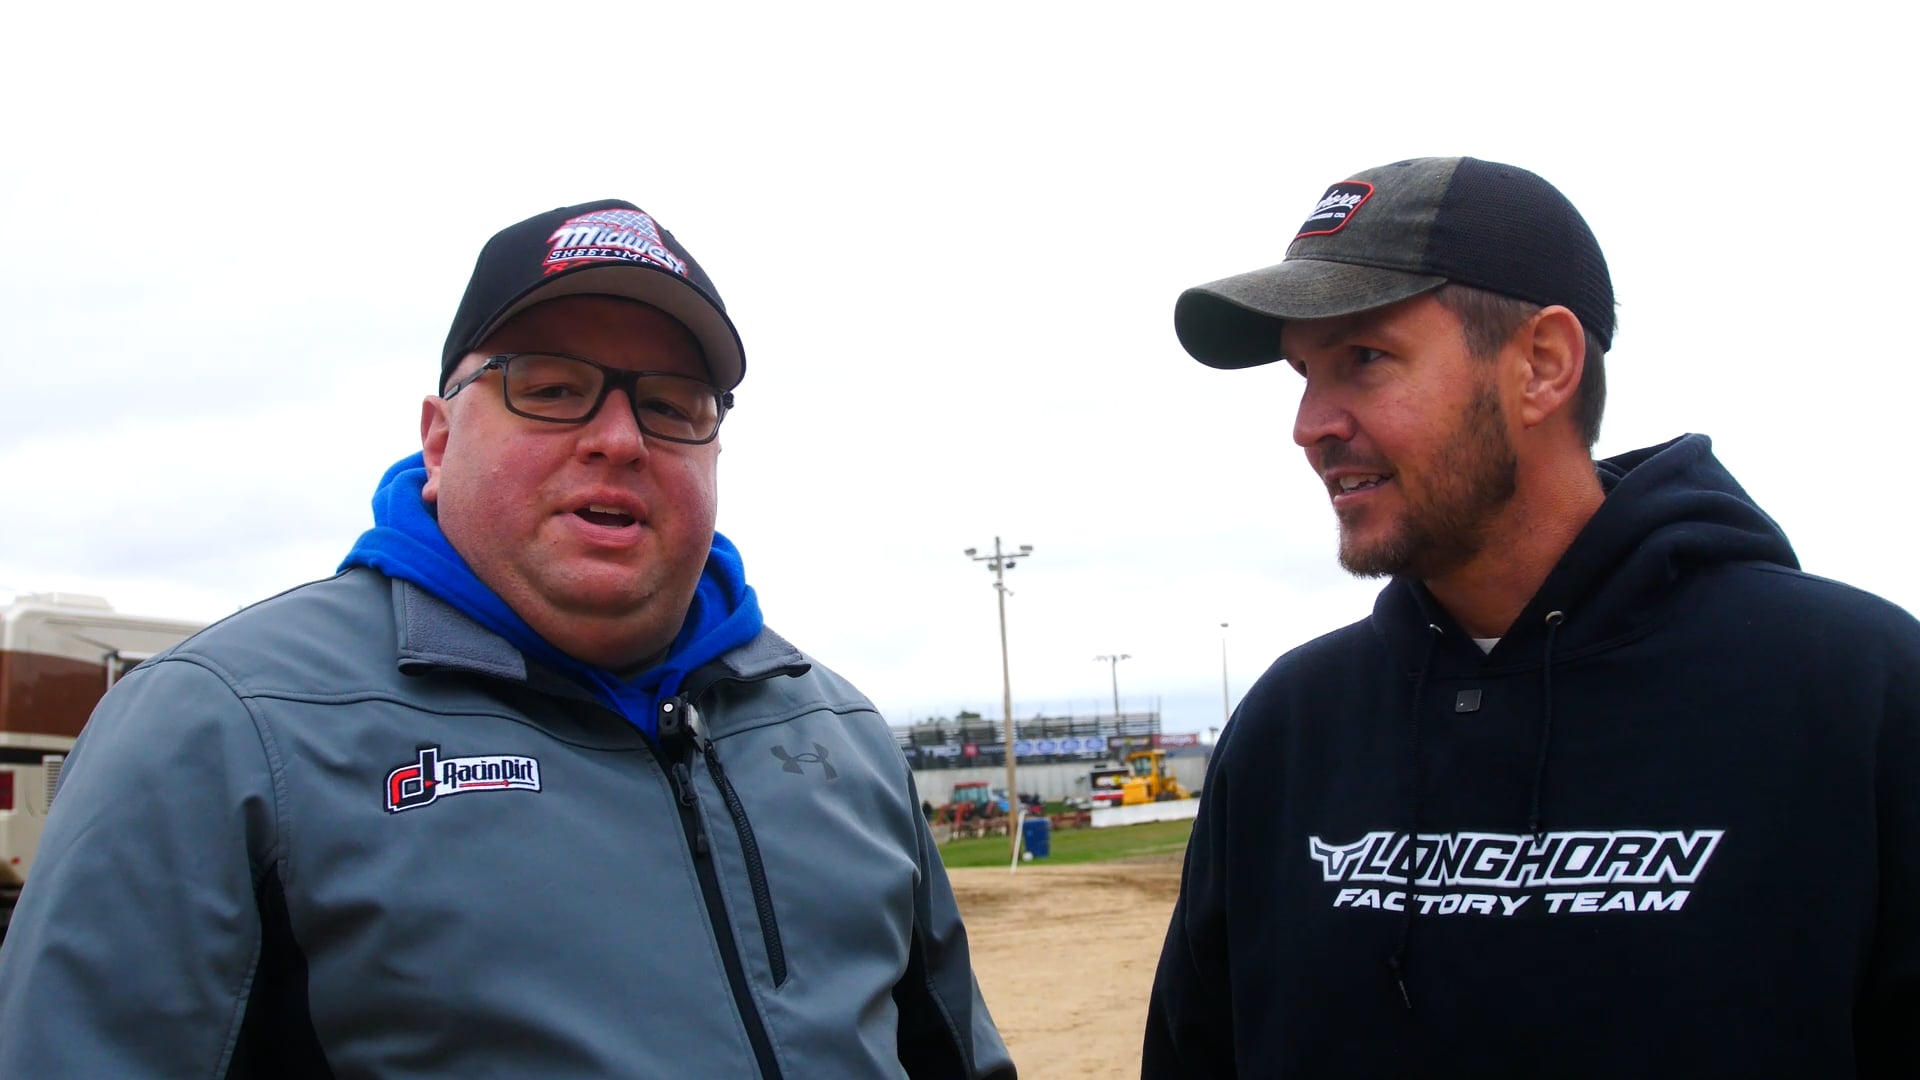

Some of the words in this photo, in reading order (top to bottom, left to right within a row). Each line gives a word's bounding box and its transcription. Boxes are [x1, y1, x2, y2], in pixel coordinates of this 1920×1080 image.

[549, 223, 686, 275] Midwest
[550, 248, 611, 260] SHEET
[443, 759, 535, 789] RacinDirt
[1348, 830, 1726, 887] LONGHORN
[1333, 888, 1532, 916] FACTORY
[1544, 890, 1691, 914] TEAM
